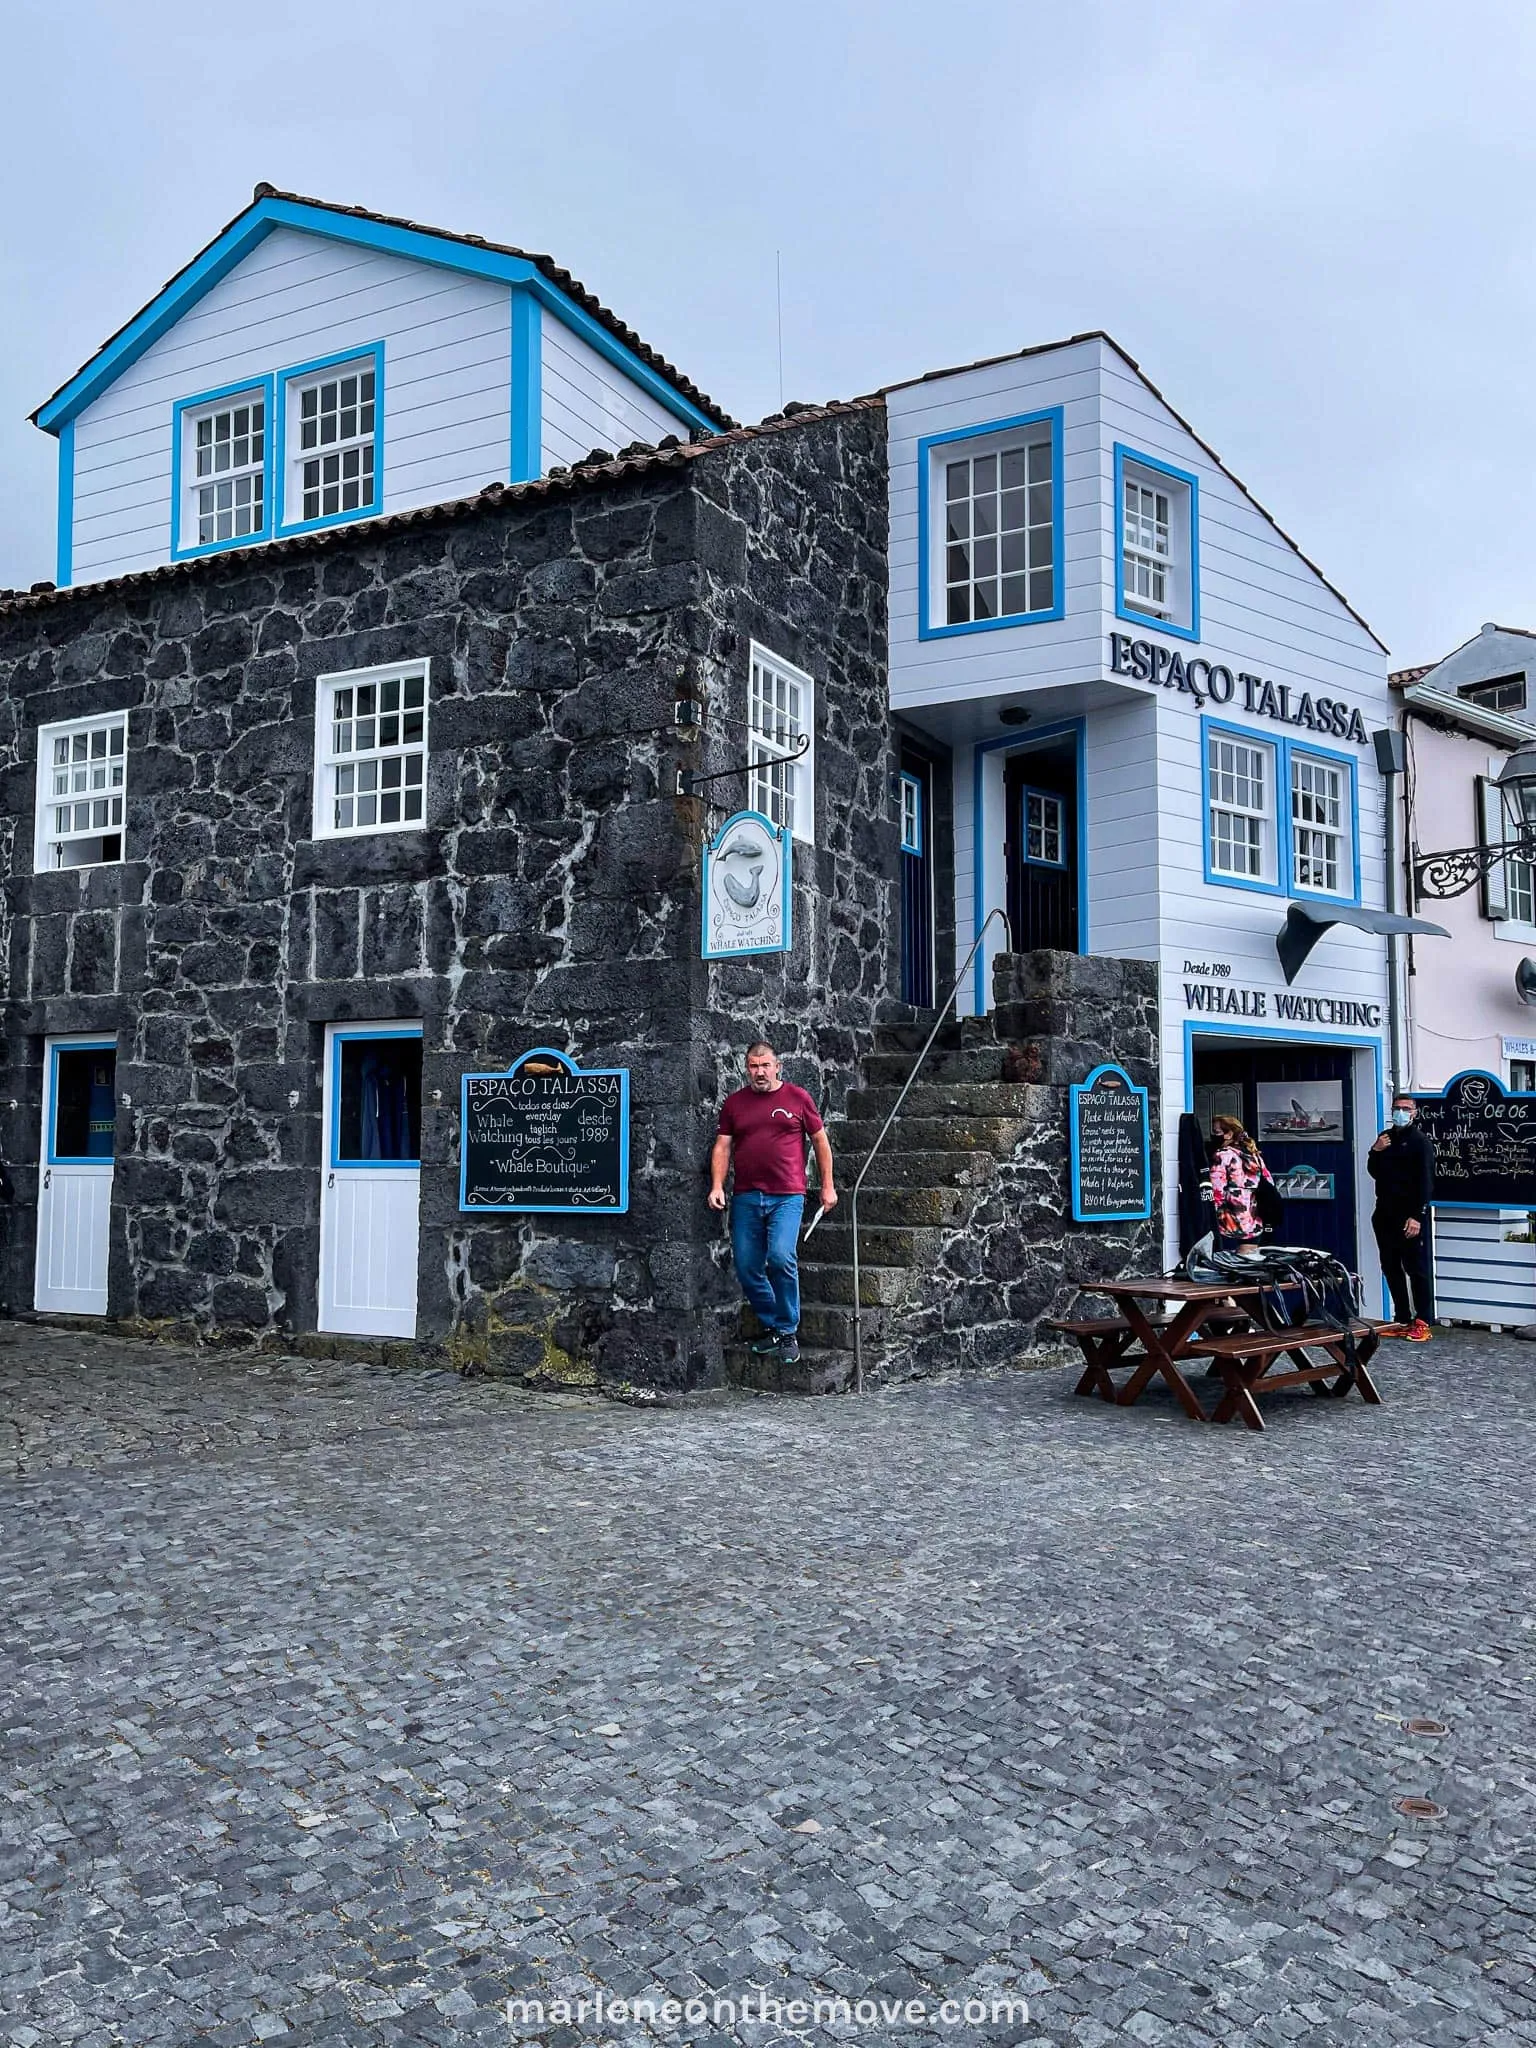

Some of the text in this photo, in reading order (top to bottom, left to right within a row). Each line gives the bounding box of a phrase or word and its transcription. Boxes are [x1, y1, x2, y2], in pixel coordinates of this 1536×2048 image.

[1110, 631, 1369, 744] ESPAÇO TALASSA
[710, 934, 780, 951] WHALE WATCHING
[1183, 961, 1231, 977] Desde 1989
[1183, 983, 1381, 1028] WHALE WATCHING
[469, 1077, 620, 1097] ESPAÇO TALASSA
[518, 1100, 540, 1110] todos
[541, 1101, 551, 1110] os
[1078, 1093, 1106, 1106] ESPAÇO
[1108, 1095, 1141, 1106] TALASSA
[476, 1114, 514, 1128] Whale
[525, 1110, 562, 1122] everyday
[577, 1107, 612, 1125] desde
[468, 1129, 523, 1147] Watching
[525, 1134, 541, 1144] tous
[555, 1136, 578, 1146] jours
[580, 1127, 609, 1143] 1989
